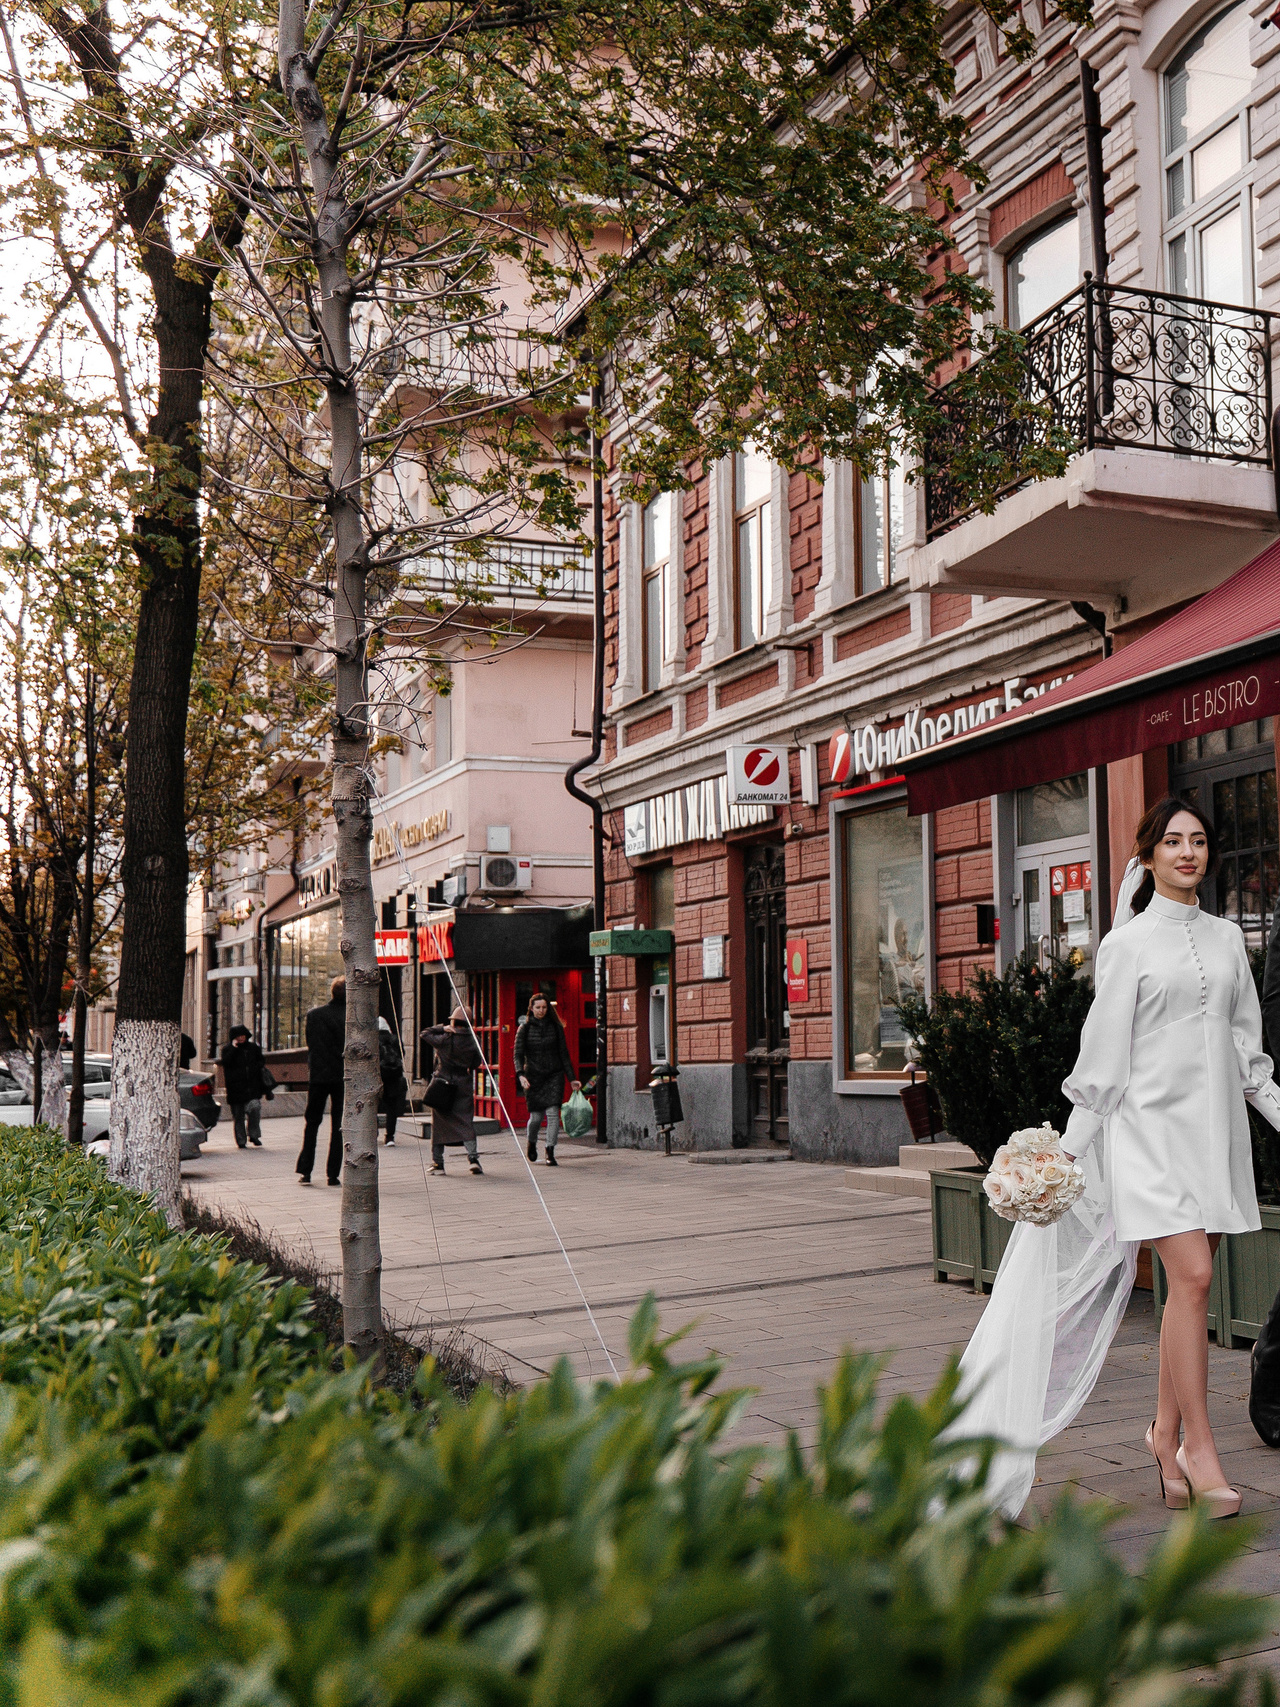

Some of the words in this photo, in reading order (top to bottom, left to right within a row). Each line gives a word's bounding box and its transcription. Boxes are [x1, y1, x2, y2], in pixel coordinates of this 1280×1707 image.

[1183, 693, 1200, 725] LE
[1204, 675, 1260, 718] BISTRO
[649, 789, 684, 852] АВИА
[685, 778, 718, 841] Ж/Д
[737, 792, 779, 801] БАНКОМАТ
[779, 793, 788, 801] 24
